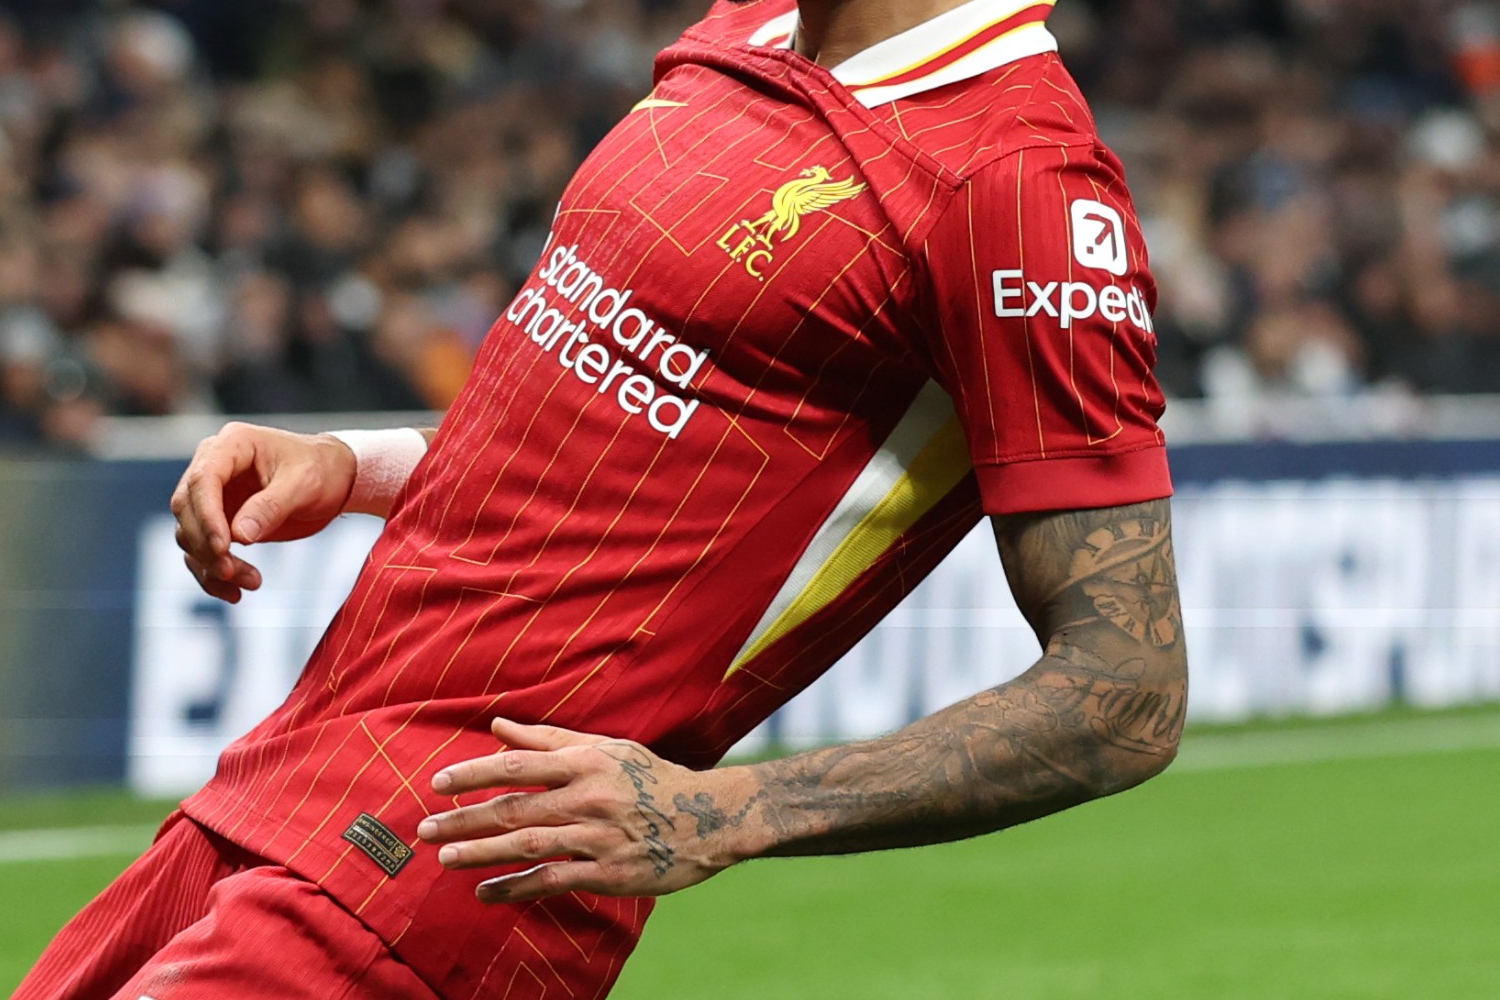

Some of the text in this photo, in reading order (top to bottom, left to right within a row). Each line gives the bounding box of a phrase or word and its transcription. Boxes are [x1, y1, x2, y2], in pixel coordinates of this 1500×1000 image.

[506, 285, 701, 440] chartered
[538, 243, 711, 390] standard
[992, 269, 1154, 334] Expedi
